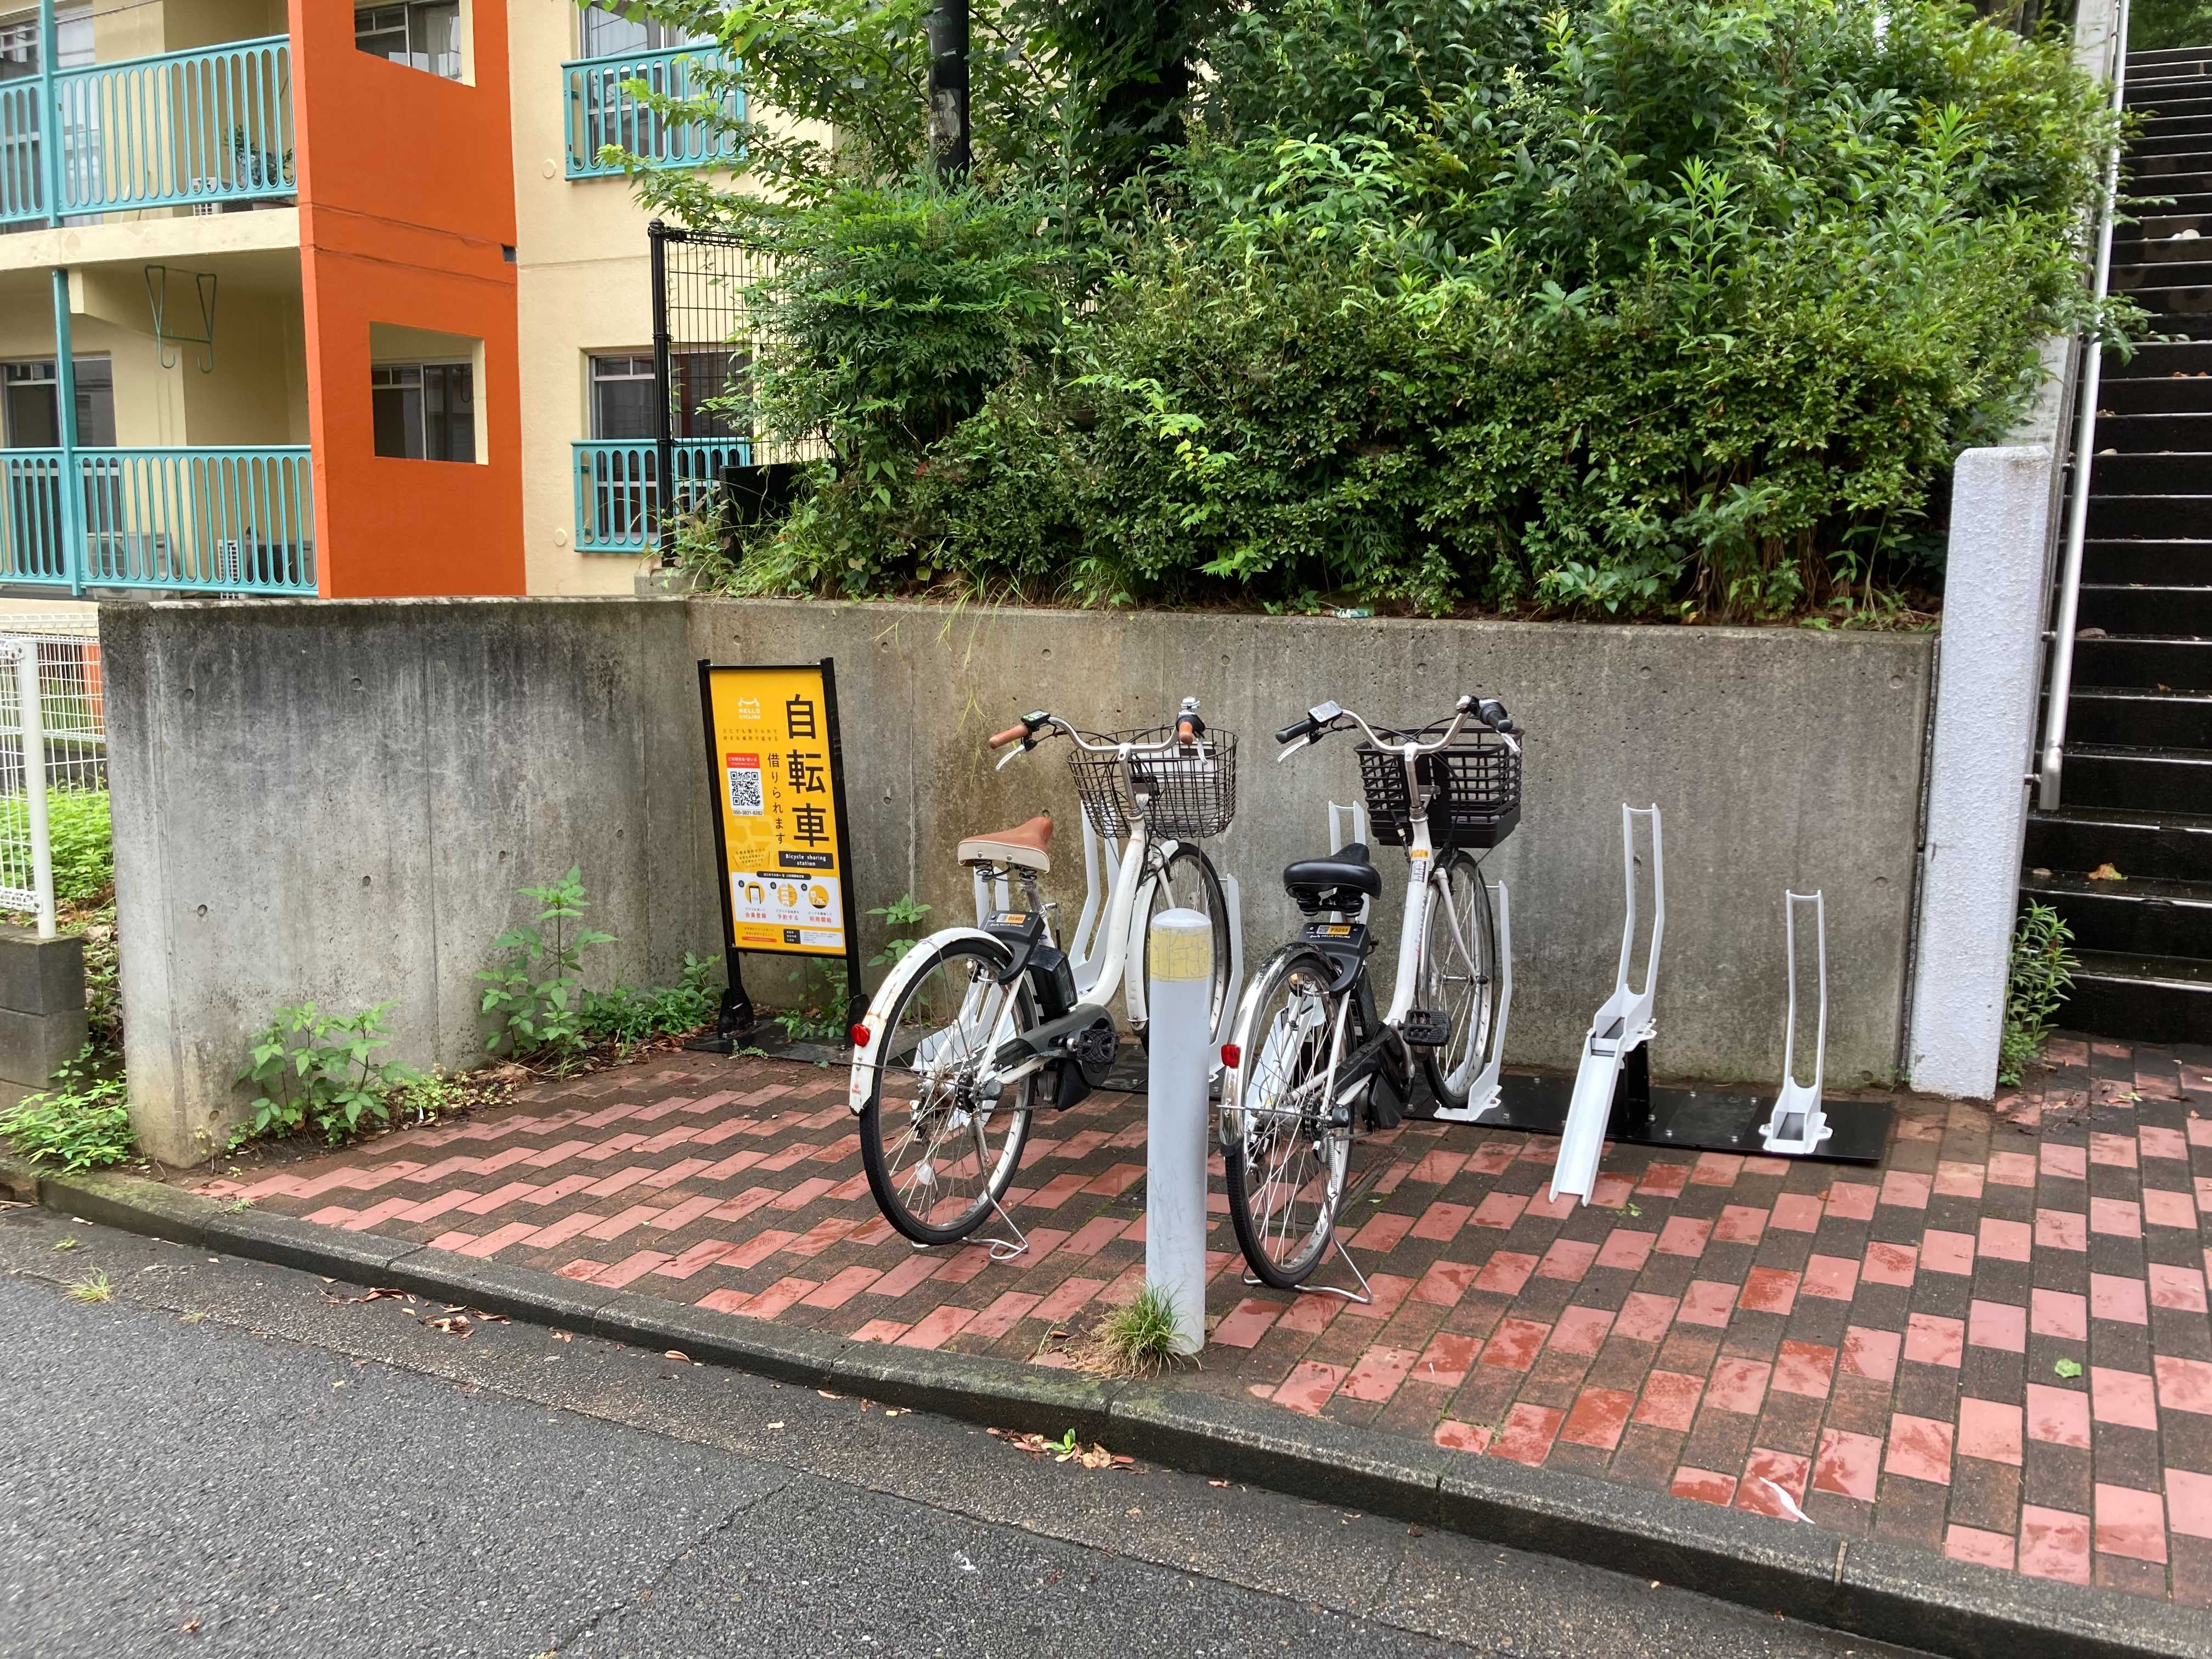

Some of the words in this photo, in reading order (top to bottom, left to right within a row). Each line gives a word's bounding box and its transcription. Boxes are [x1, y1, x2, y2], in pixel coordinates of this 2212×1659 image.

[768, 753, 785, 844] 借りられます
[786, 694, 830, 847] 自転車
